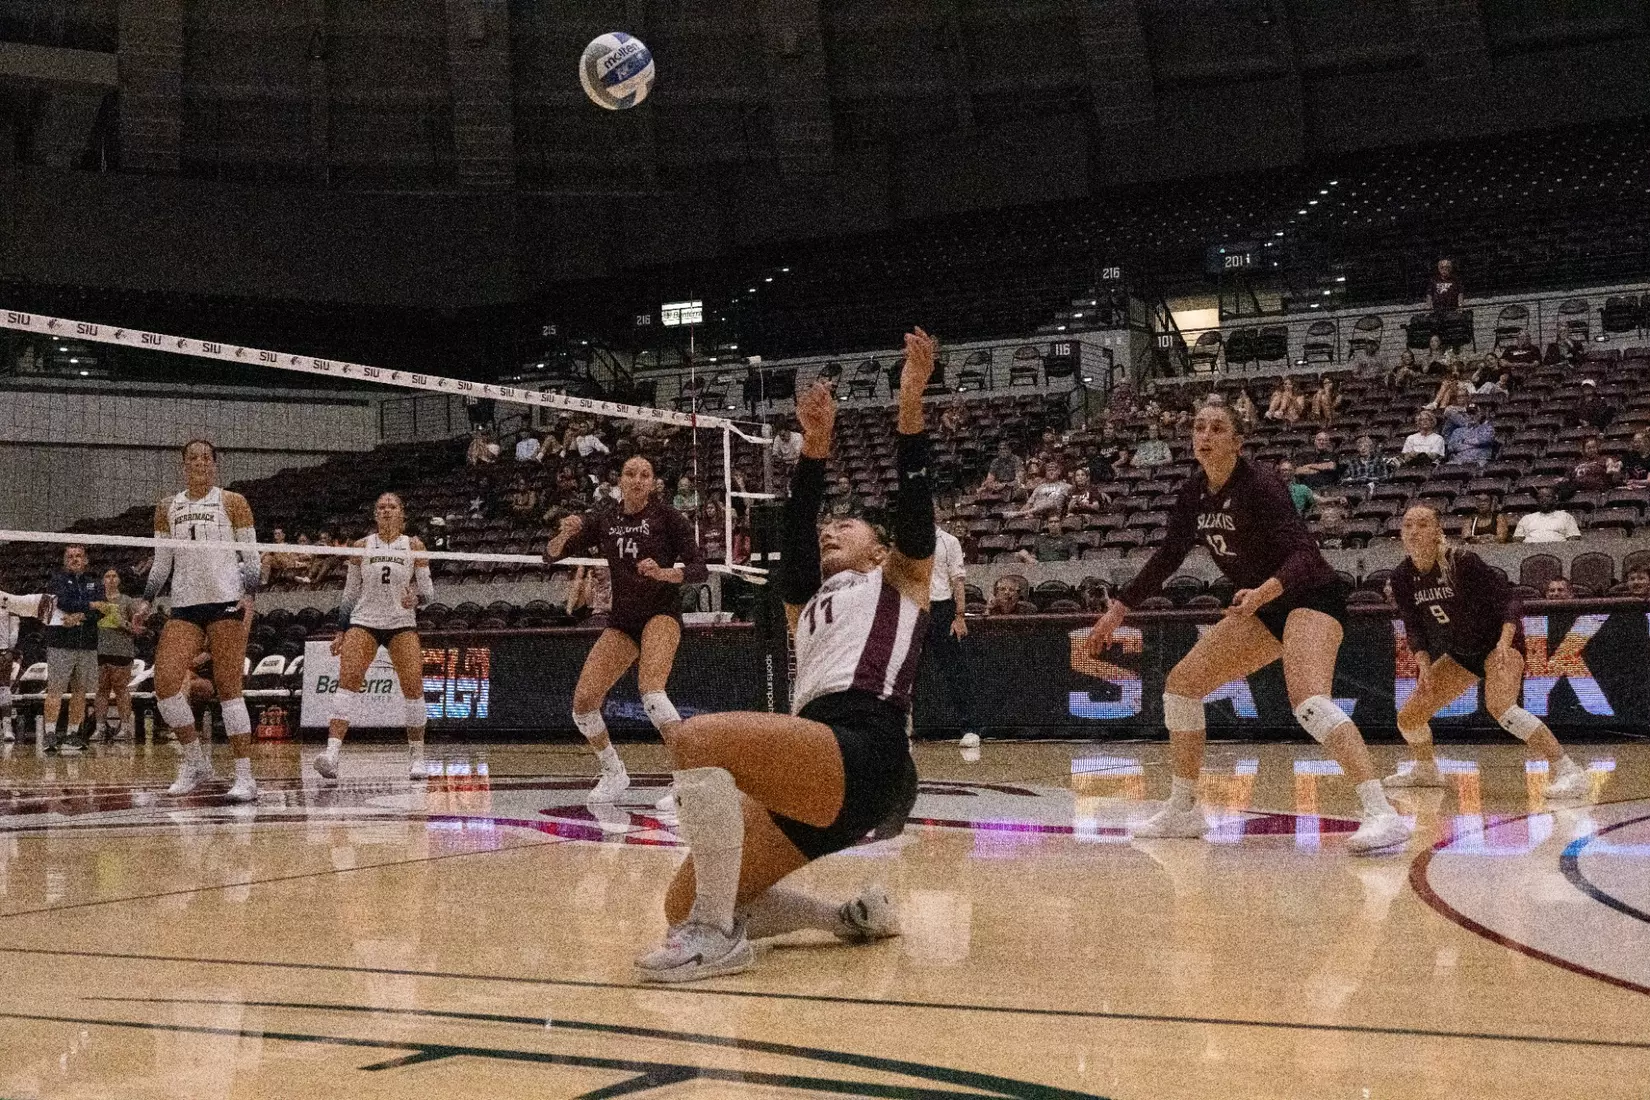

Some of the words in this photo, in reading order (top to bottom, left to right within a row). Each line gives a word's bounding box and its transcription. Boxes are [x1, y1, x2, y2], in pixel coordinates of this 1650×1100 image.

[604, 43, 640, 69] molten
[1225, 255, 1243, 268] 201
[1103, 267, 1120, 279] 216
[1055, 343, 1071, 356] 116
[1158, 335, 1173, 348] 101
[8, 312, 31, 326] SIU
[77, 323, 98, 336] SIU
[142, 333, 162, 345] SIU
[202, 342, 221, 354] SIU
[259, 351, 277, 363] SIU
[313, 359, 330, 371] SIU
[364, 367, 380, 378] SIU
[412, 374, 427, 385] SIU
[457, 381, 473, 391] SIU
[500, 387, 515, 397] SIU
[541, 393, 555, 403] SIU
[580, 399, 592, 408] SIU
[617, 404, 629, 413] SIU
[652, 409, 664, 418] SIU
[616, 537, 639, 559] 14
[381, 565, 391, 585] 2
[1413, 586, 1455, 606] SALUKIS
[1429, 604, 1450, 624] 9
[765, 654, 774, 681] sports
[315, 675, 393, 693] Baerra
